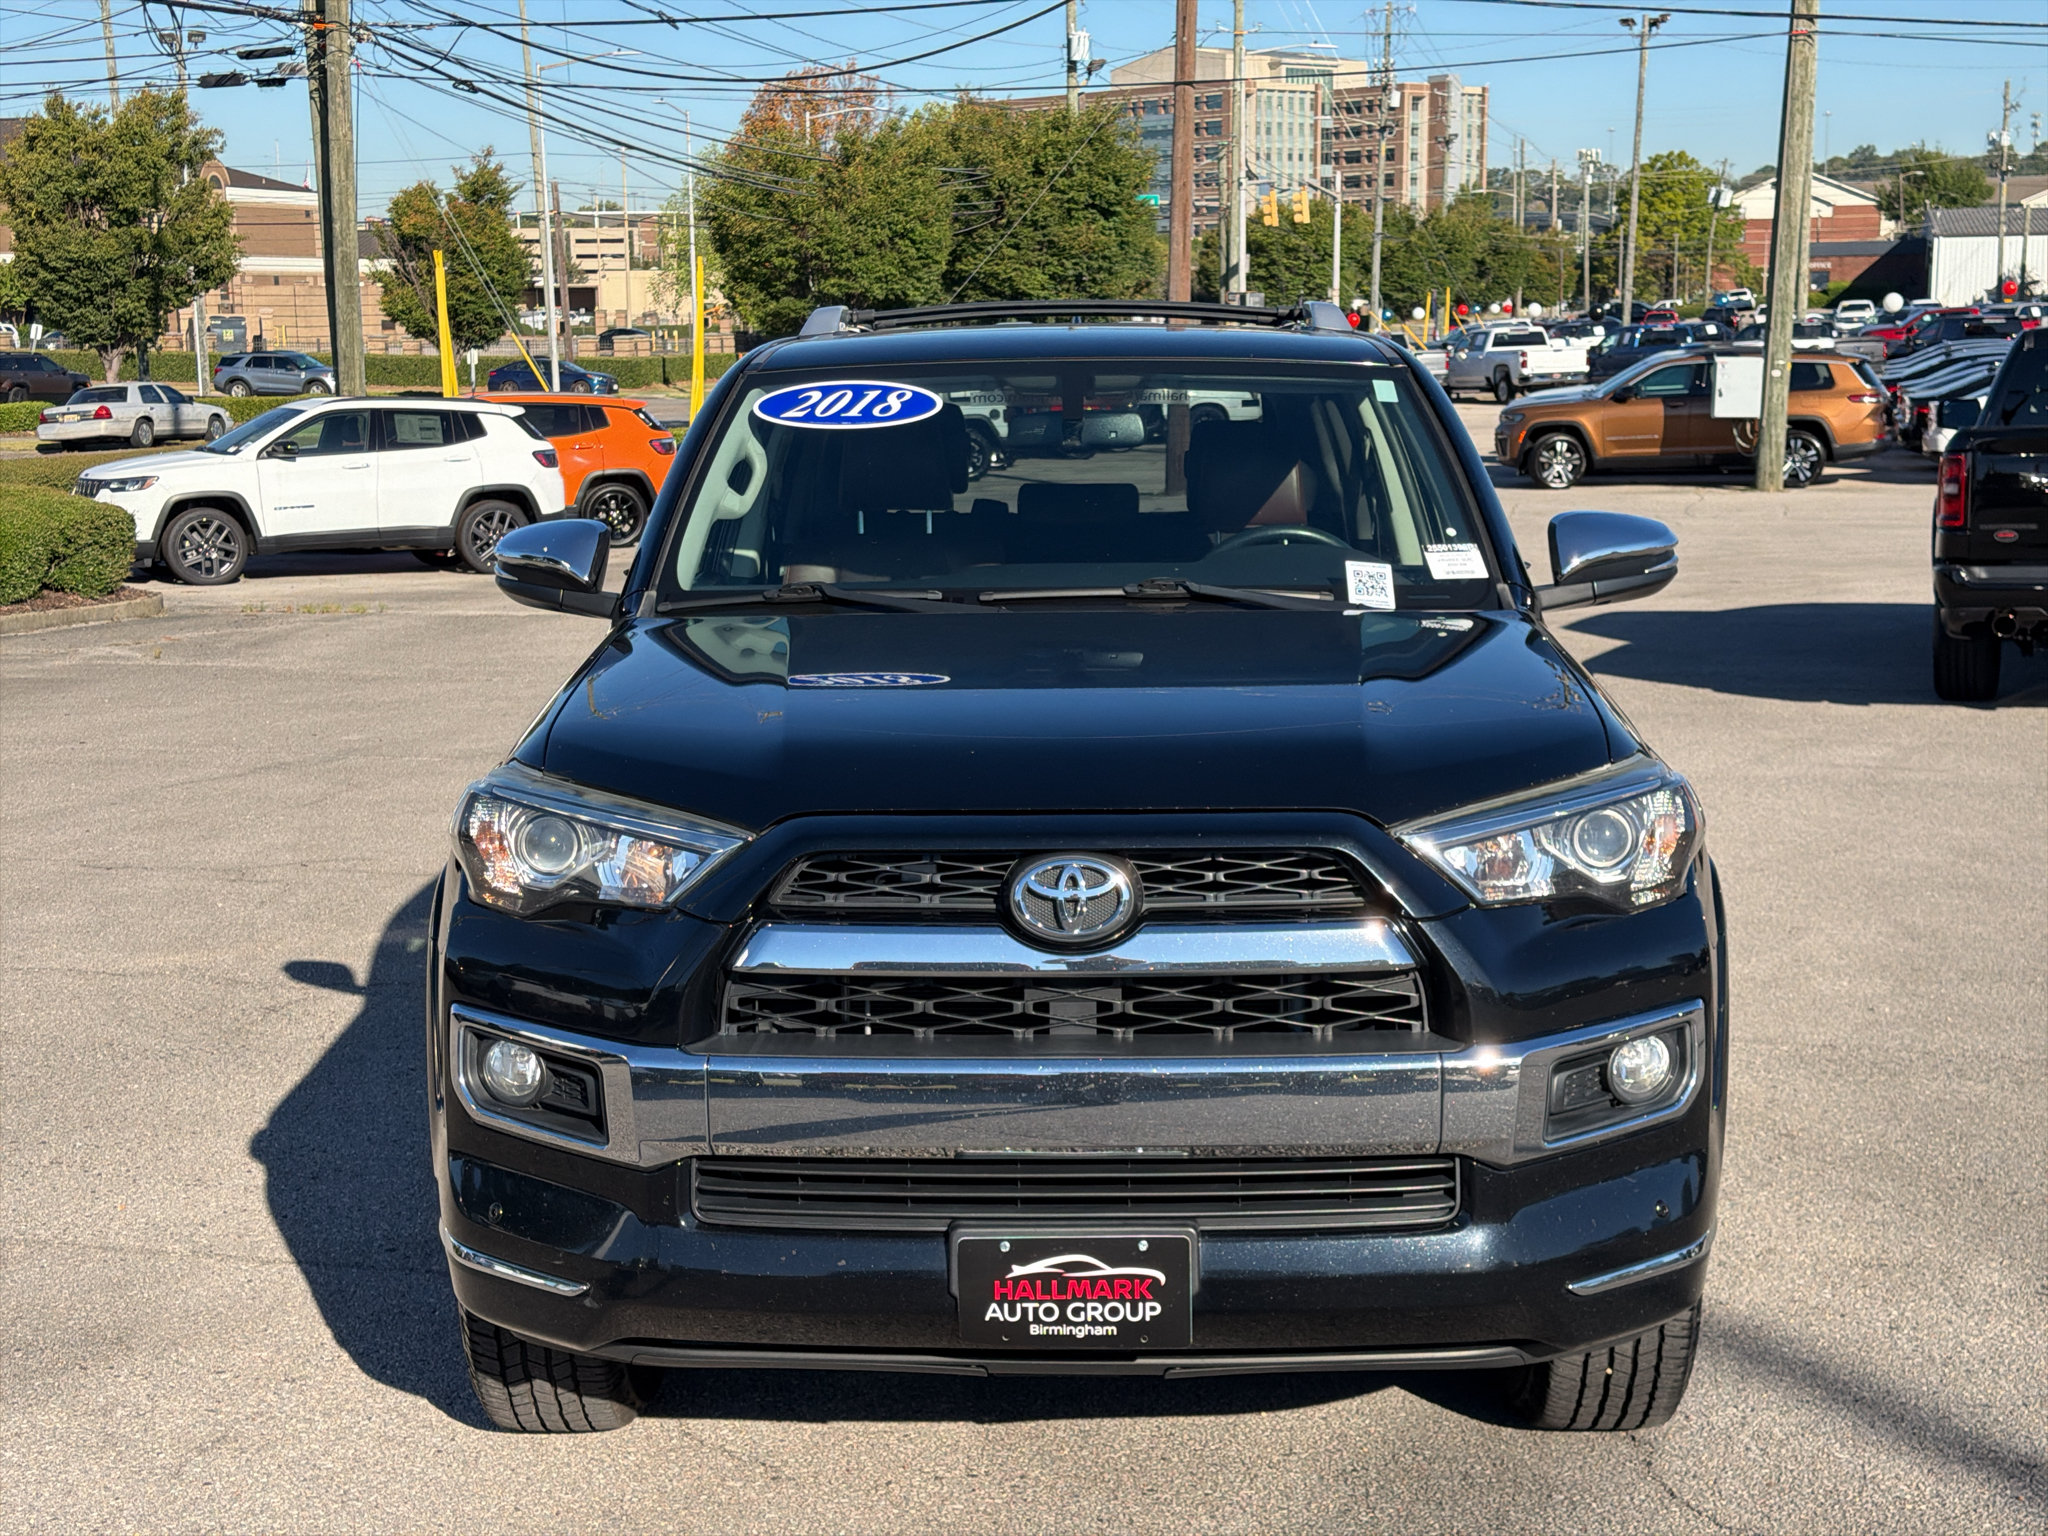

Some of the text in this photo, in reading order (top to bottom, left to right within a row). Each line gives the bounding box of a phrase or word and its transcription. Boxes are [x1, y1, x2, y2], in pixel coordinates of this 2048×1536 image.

[779, 389, 913, 418] 2018
[993, 1278, 1153, 1300] HALLMARK
[984, 1302, 1162, 1322] AUTO GROUP
[1029, 1324, 1117, 1338] Birmingham
